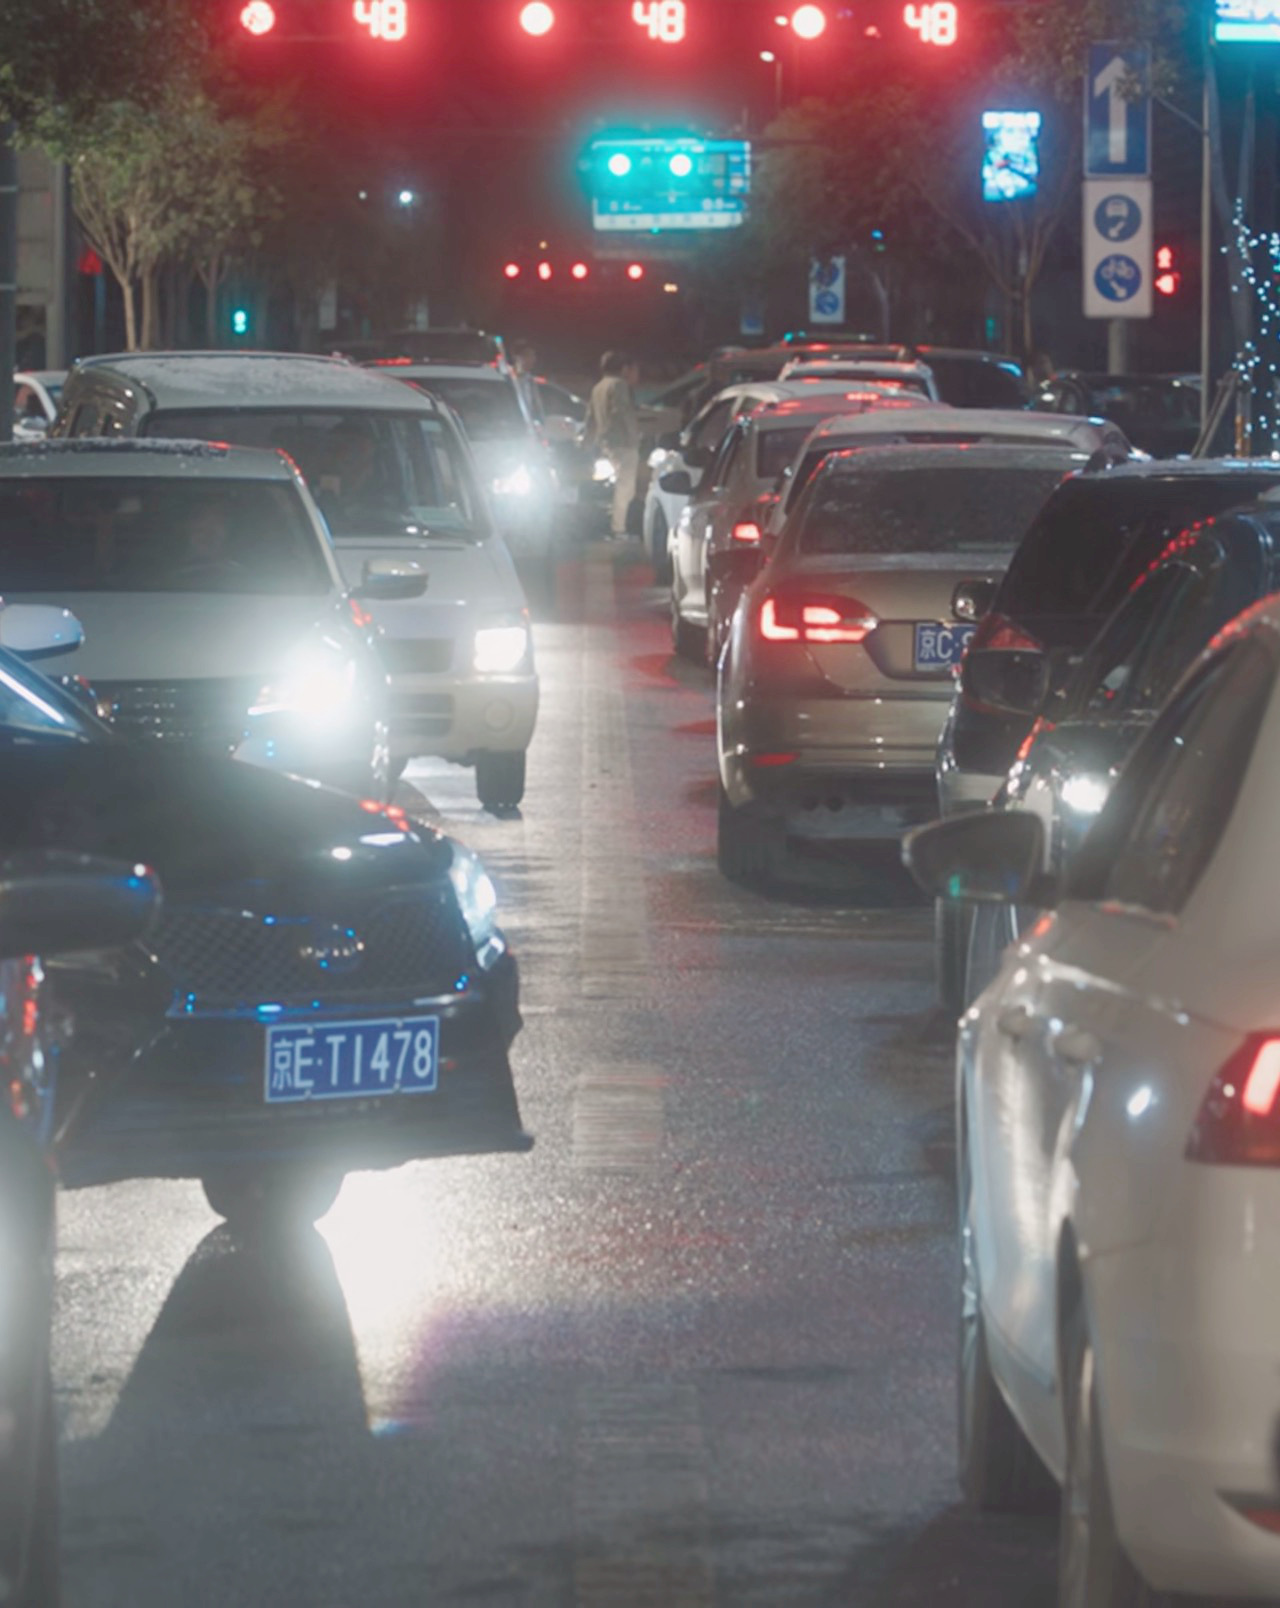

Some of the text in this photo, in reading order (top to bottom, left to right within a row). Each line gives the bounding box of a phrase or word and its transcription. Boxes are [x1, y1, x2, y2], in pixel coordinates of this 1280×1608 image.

[353, 0, 407, 41] 48
[632, 0, 686, 43] 48
[903, 2, 957, 46] 48
